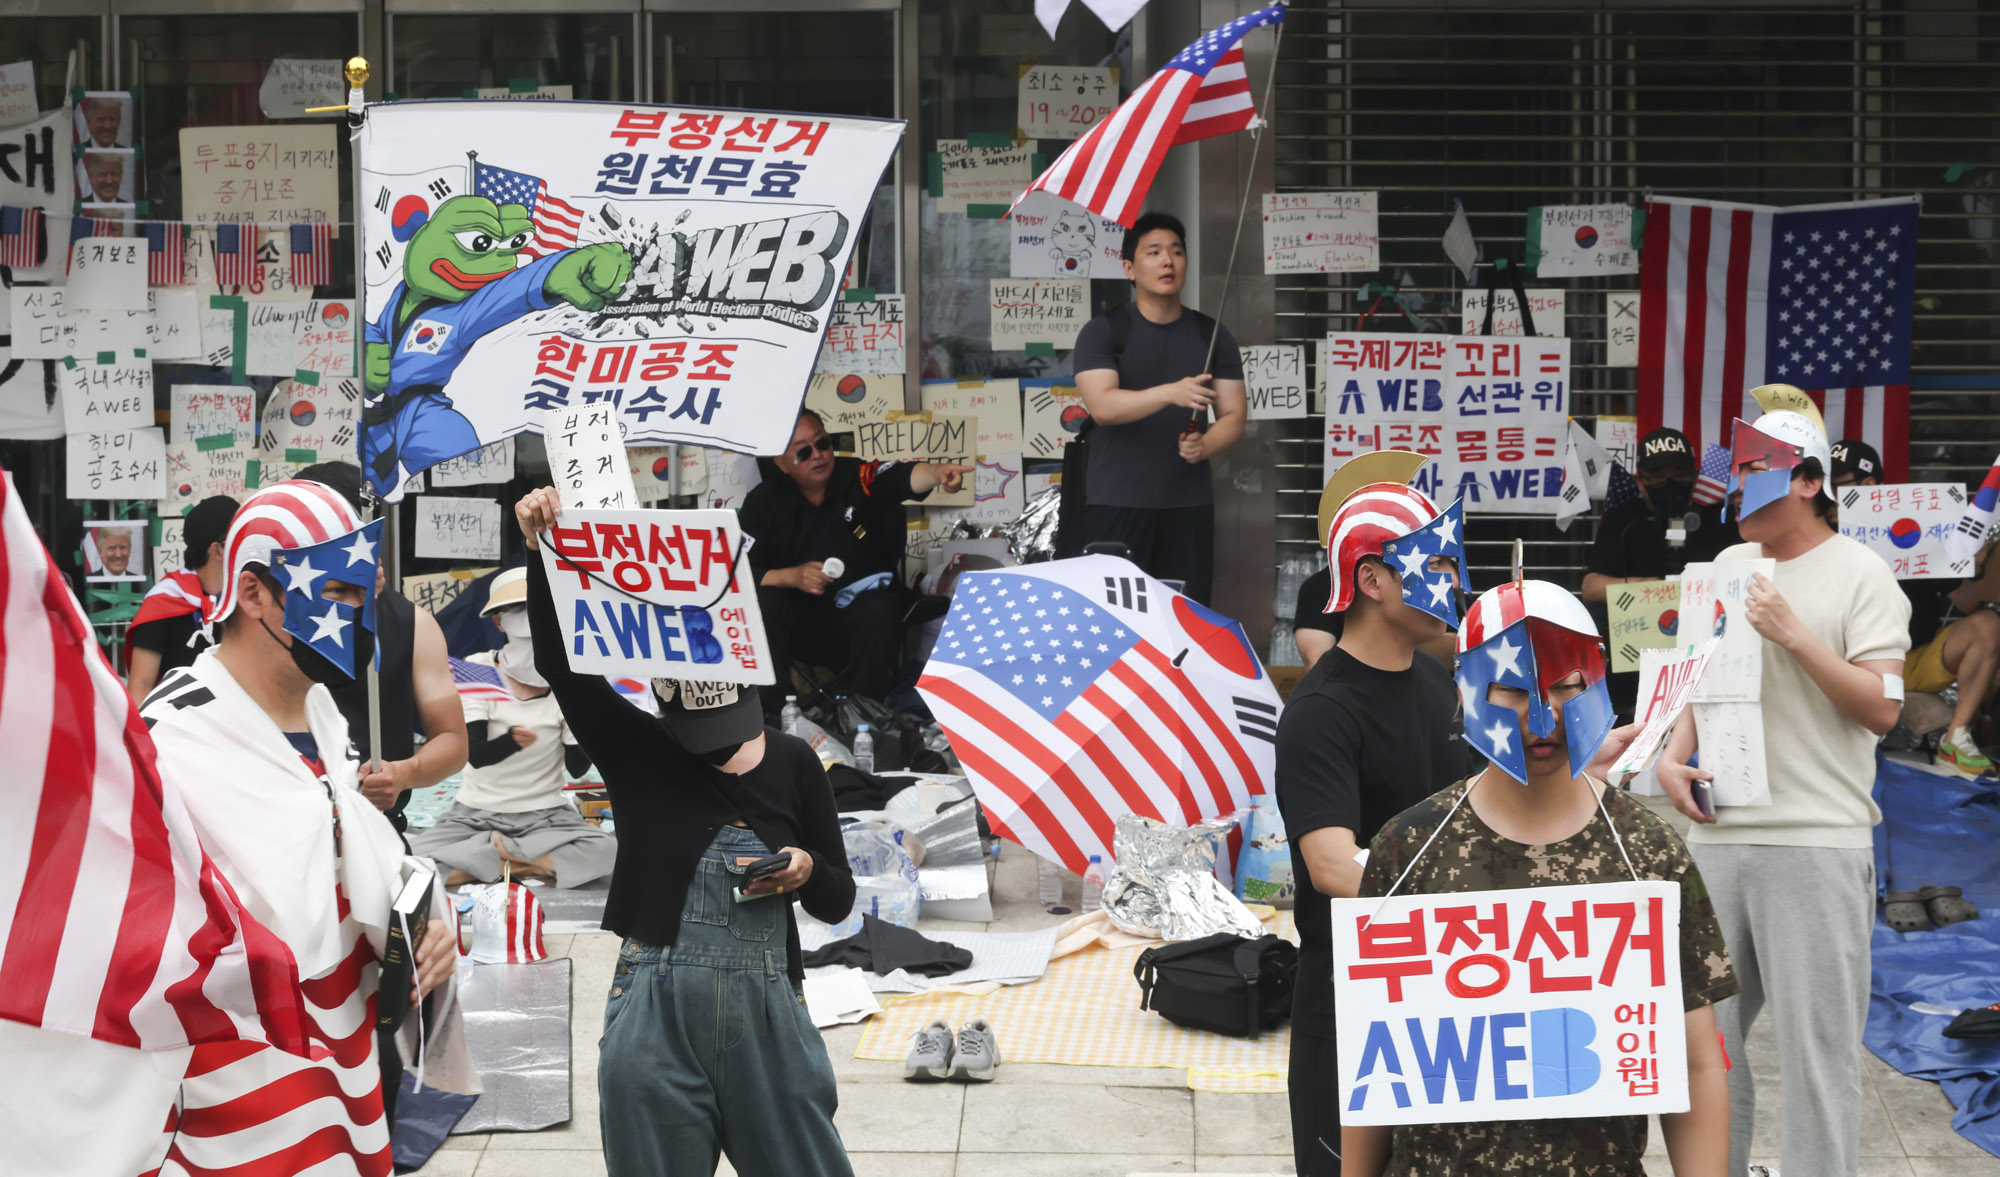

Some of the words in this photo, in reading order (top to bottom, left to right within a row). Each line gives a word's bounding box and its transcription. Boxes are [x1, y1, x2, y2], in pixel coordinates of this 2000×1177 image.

[1028, 72, 1062, 91] 최소
[610, 109, 831, 157] 부정선거
[193, 143, 279, 173] 투표용지
[282, 149, 335, 169] 지키자!
[594, 152, 809, 199] 원천무효
[215, 179, 296, 204] 증거보존
[1544, 208, 1593, 227] 부정선거
[76, 245, 136, 269] 증거보존
[994, 285, 1036, 305] 반드시
[1041, 284, 1083, 304] 자리를
[602, 301, 660, 315] Association
[661, 301, 674, 312] of
[675, 300, 709, 313] World
[711, 301, 760, 317] Election
[762, 303, 816, 330] Bodies
[853, 298, 904, 326] 수개표
[1003, 305, 1075, 321] 지켜주세요
[534, 336, 739, 384] 한미공조
[1331, 339, 1447, 372] 국제기관
[1455, 342, 1521, 378] 꼬리
[75, 367, 109, 396] 국내
[1247, 386, 1303, 410] WEB
[1456, 380, 1563, 416] 선관위
[561, 409, 609, 447] 부정
[858, 419, 966, 457] FREEDOM
[88, 432, 133, 459] 한미
[1455, 427, 1526, 463] 몸통
[87, 459, 159, 490] 공조수사
[566, 454, 614, 489] 증거
[1910, 487, 1943, 511] 투표
[551, 520, 741, 594] 부정선거
[574, 598, 724, 665] AWEB
[695, 692, 725, 708] OUT
[1347, 897, 1667, 1004] 부정선거
[1347, 1007, 1601, 1112] AWEB
[1614, 1001, 1660, 1098] 에이웹
